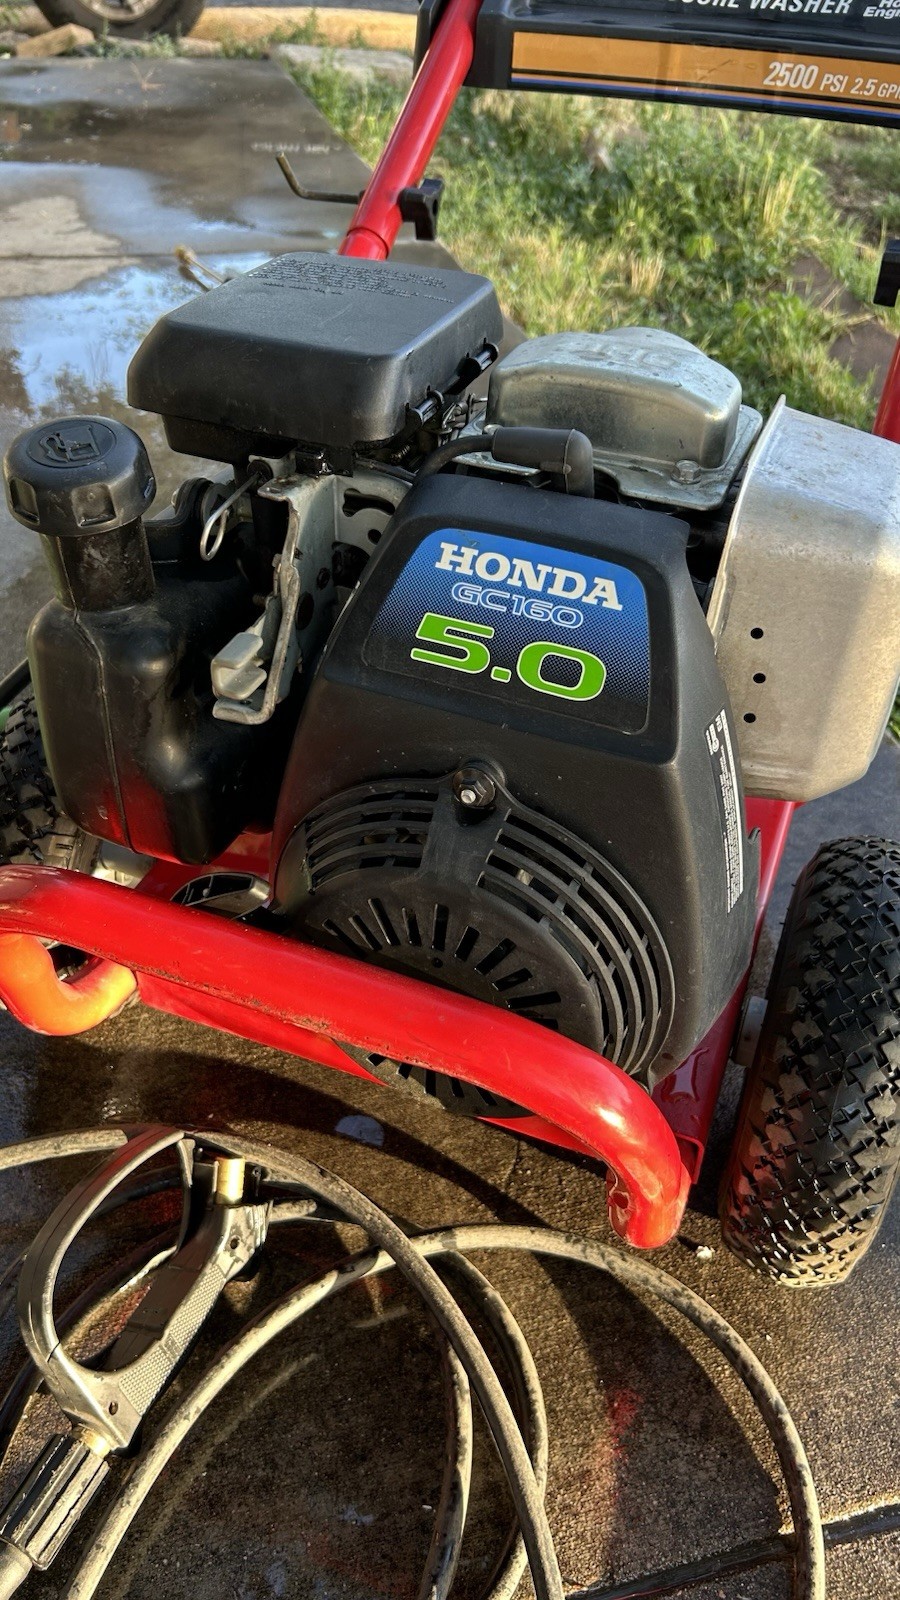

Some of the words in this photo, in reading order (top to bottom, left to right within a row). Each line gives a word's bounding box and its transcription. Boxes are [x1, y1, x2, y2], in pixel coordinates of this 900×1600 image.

[763, 61, 819, 89] 2500
[820, 73, 848, 92] PSI
[850, 77, 878, 96] 2.5
[435, 543, 623, 611] HONDA
[452, 582, 584, 629] GC160
[411, 612, 607, 701] 5.0
